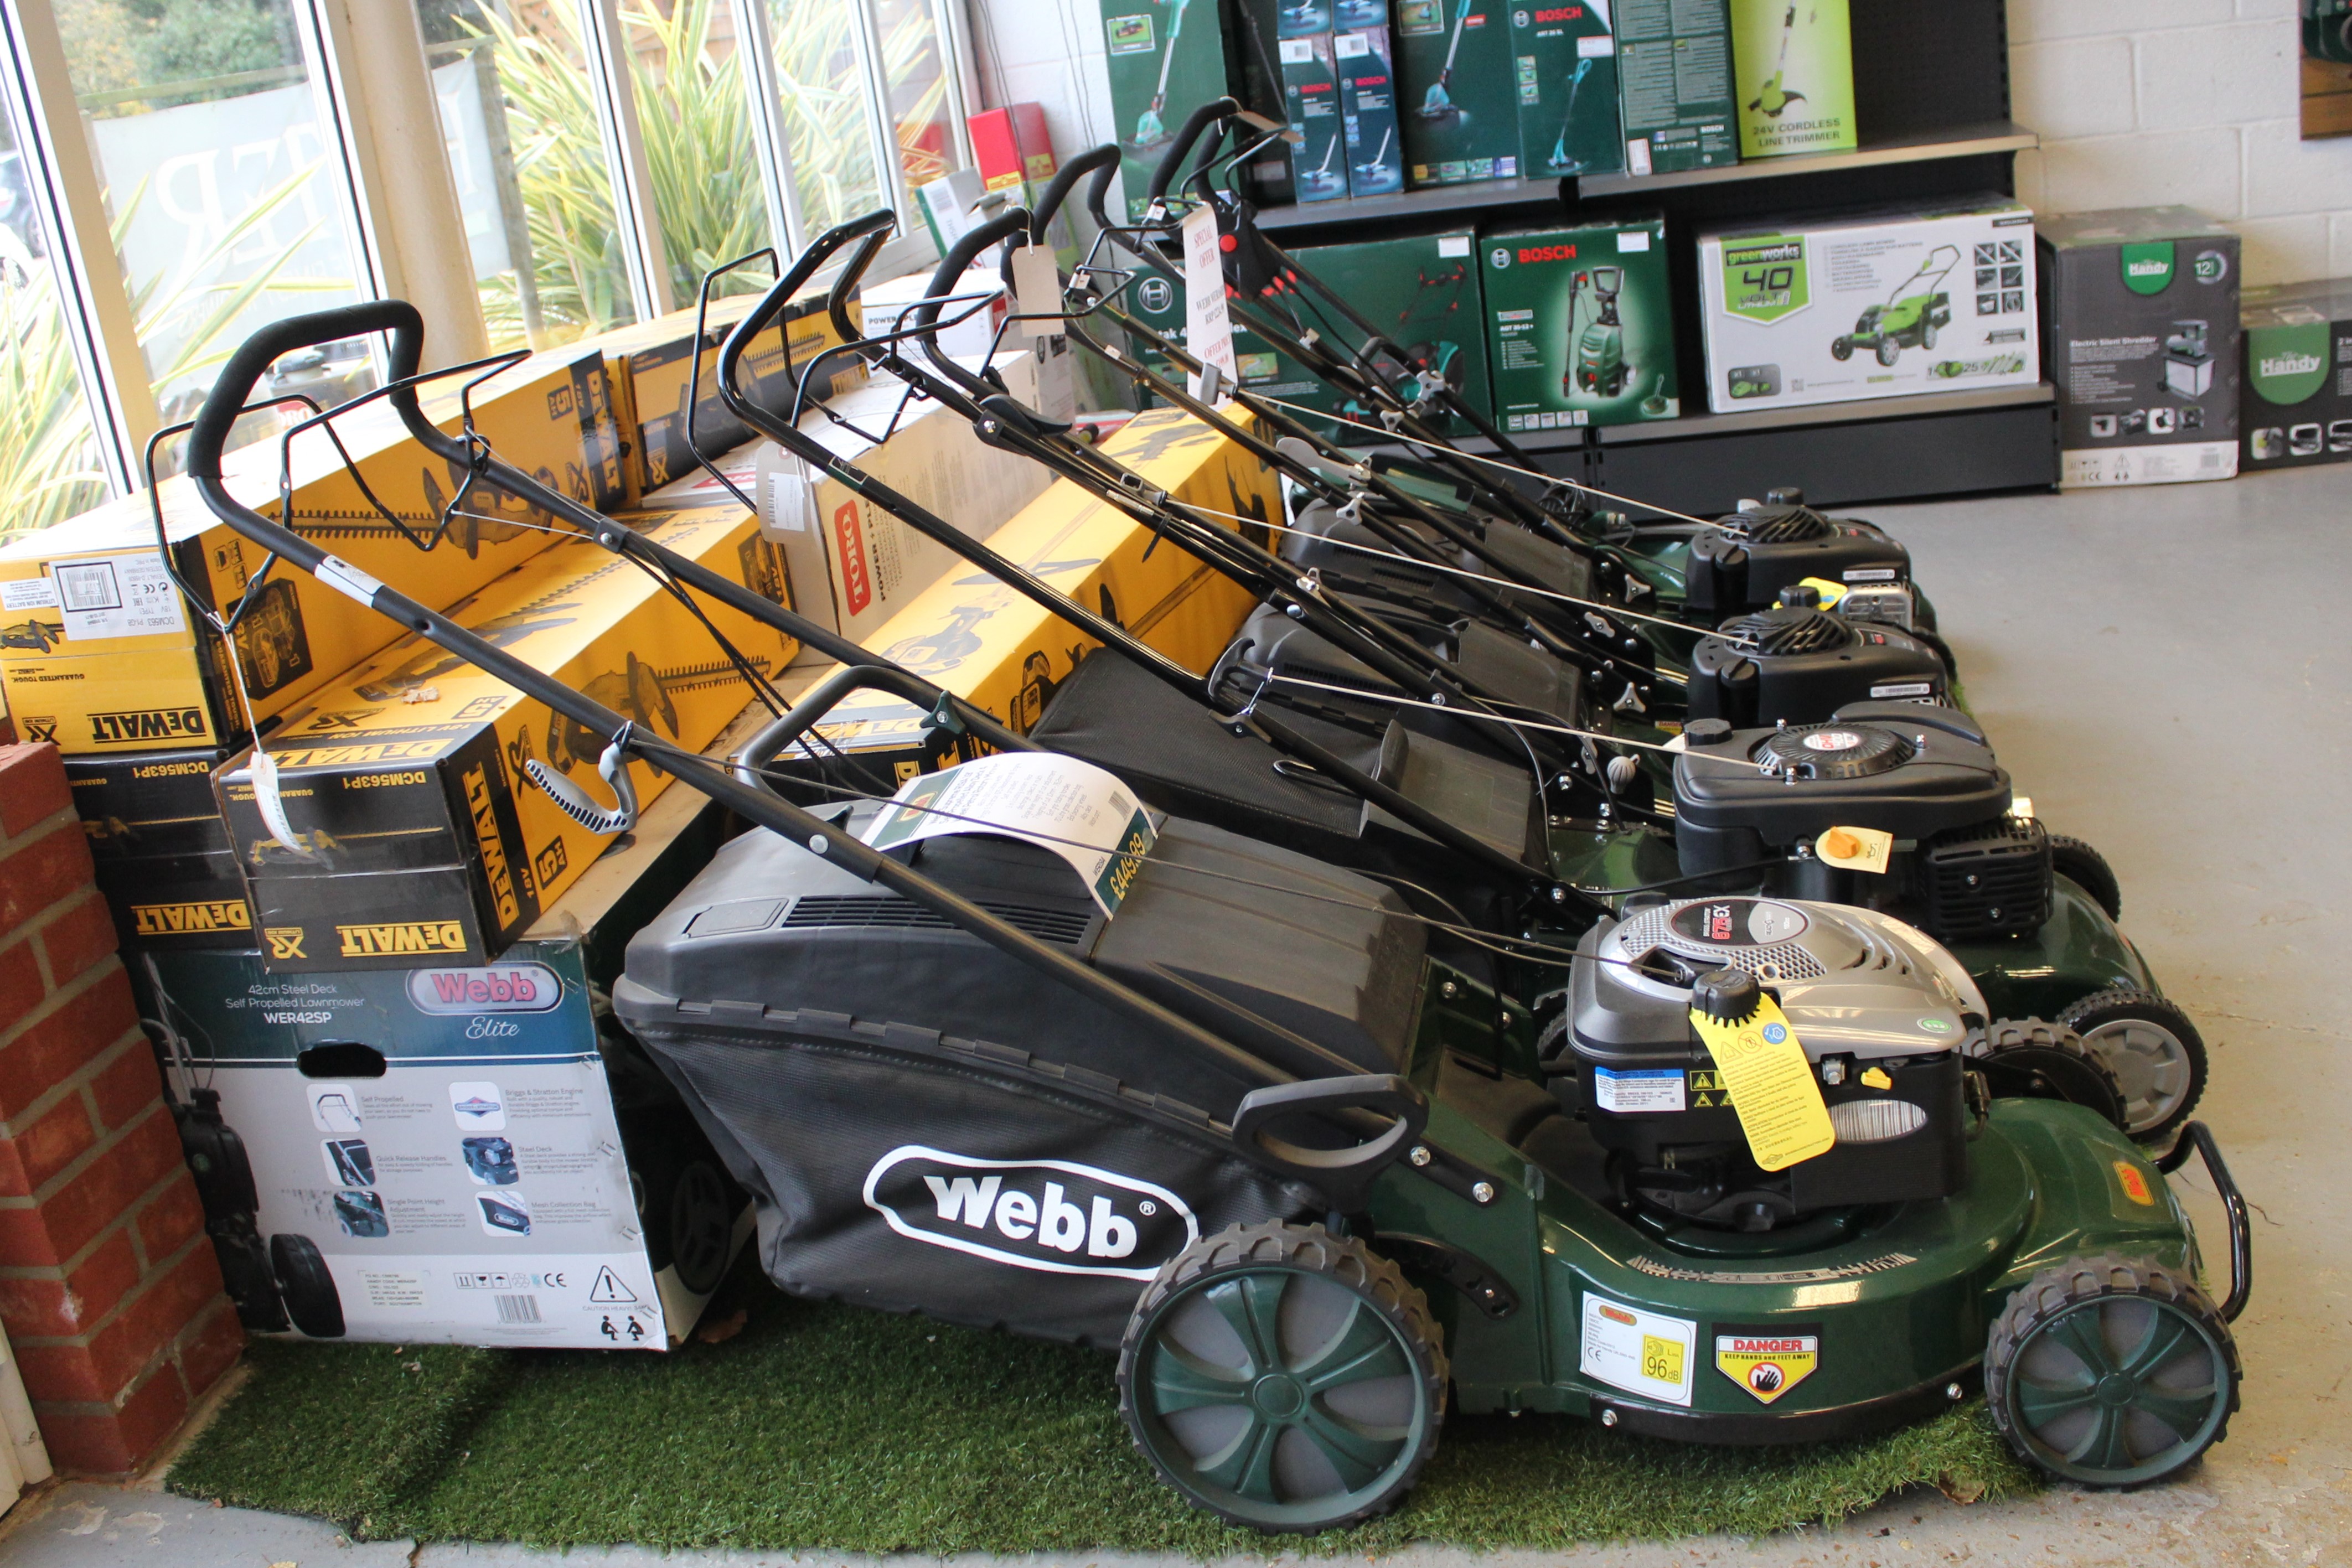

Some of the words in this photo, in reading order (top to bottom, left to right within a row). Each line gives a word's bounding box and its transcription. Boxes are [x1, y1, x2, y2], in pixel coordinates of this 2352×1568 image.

[1534, 7, 1582, 23] BOSCH
[1700, 124, 1724, 133] BOSCH
[1753, 124, 1775, 135] 24V
[1779, 118, 1841, 133] CORDLESS
[1758, 136, 1783, 147] LINE
[1786, 130, 1841, 144] TRIMMER
[1199, 247, 1215, 268] OFFER
[1518, 245, 1576, 263] BOSCH
[1728, 245, 1800, 266] greenworks
[2129, 262, 2168, 276] Handy
[2196, 261, 2210, 275] 12
[1744, 266, 1794, 292] 40
[869, 316, 897, 325] POWER
[2261, 356, 2320, 377] Handy
[842, 514, 864, 603] TORO
[872, 544, 885, 601] POWER
[39, 674, 85, 682] GUARANTEED
[330, 731, 363, 740] ION
[363, 725, 442, 738] LITHIUM
[133, 762, 209, 778] DCM563P1
[343, 772, 427, 790] DCM563P1
[464, 763, 519, 930] DEWALT
[540, 853, 557, 884] 5
[519, 867, 535, 898] 18V
[268, 936, 307, 959] XR
[249, 984, 277, 995] 42cm
[281, 984, 308, 995] Steel
[311, 984, 338, 994] Deck
[431, 972, 537, 1003] Webb
[225, 997, 245, 1008] Self
[249, 997, 298, 1010] Propelled
[301, 997, 365, 1008] Lawnmower
[263, 1012, 332, 1024] WER42SP
[466, 1016, 520, 1039] Elite
[923, 1176, 1138, 1258] Webb
[1605, 1309, 1633, 1324] Webb
[1734, 1339, 1803, 1352] DANGER
[1646, 1355, 1668, 1378] 96
[1667, 1367, 1680, 1381] dB
